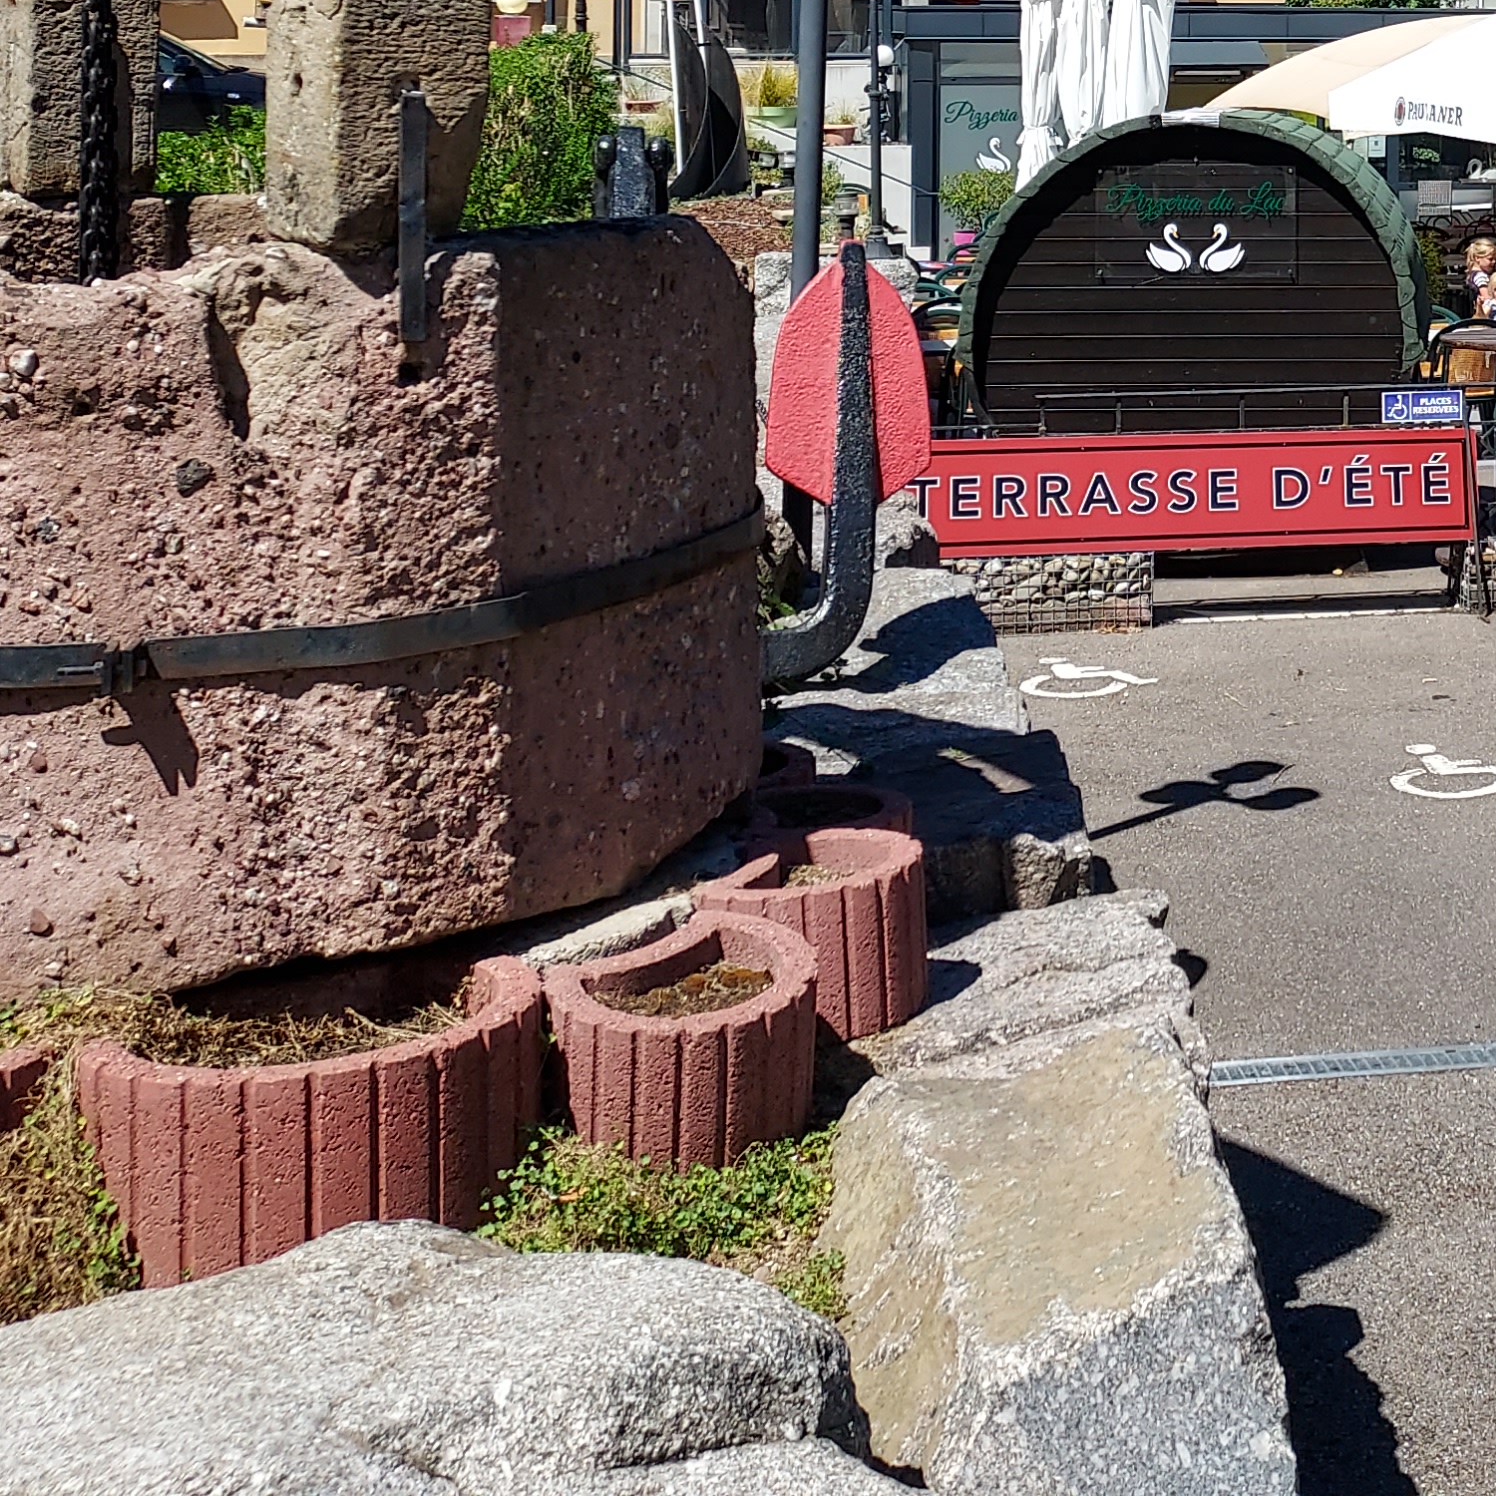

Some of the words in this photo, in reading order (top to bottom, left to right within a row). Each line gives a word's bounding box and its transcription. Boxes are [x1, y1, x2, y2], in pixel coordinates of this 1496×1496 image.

[944, 100, 1019, 131] Pizzeria
[1106, 183, 1201, 221] Pizzeria
[1208, 189, 1235, 212] du
[1240, 181, 1287, 220] Lac
[1420, 397, 1452, 406] PLACES
[904, 468, 1240, 520] TERRASSE
